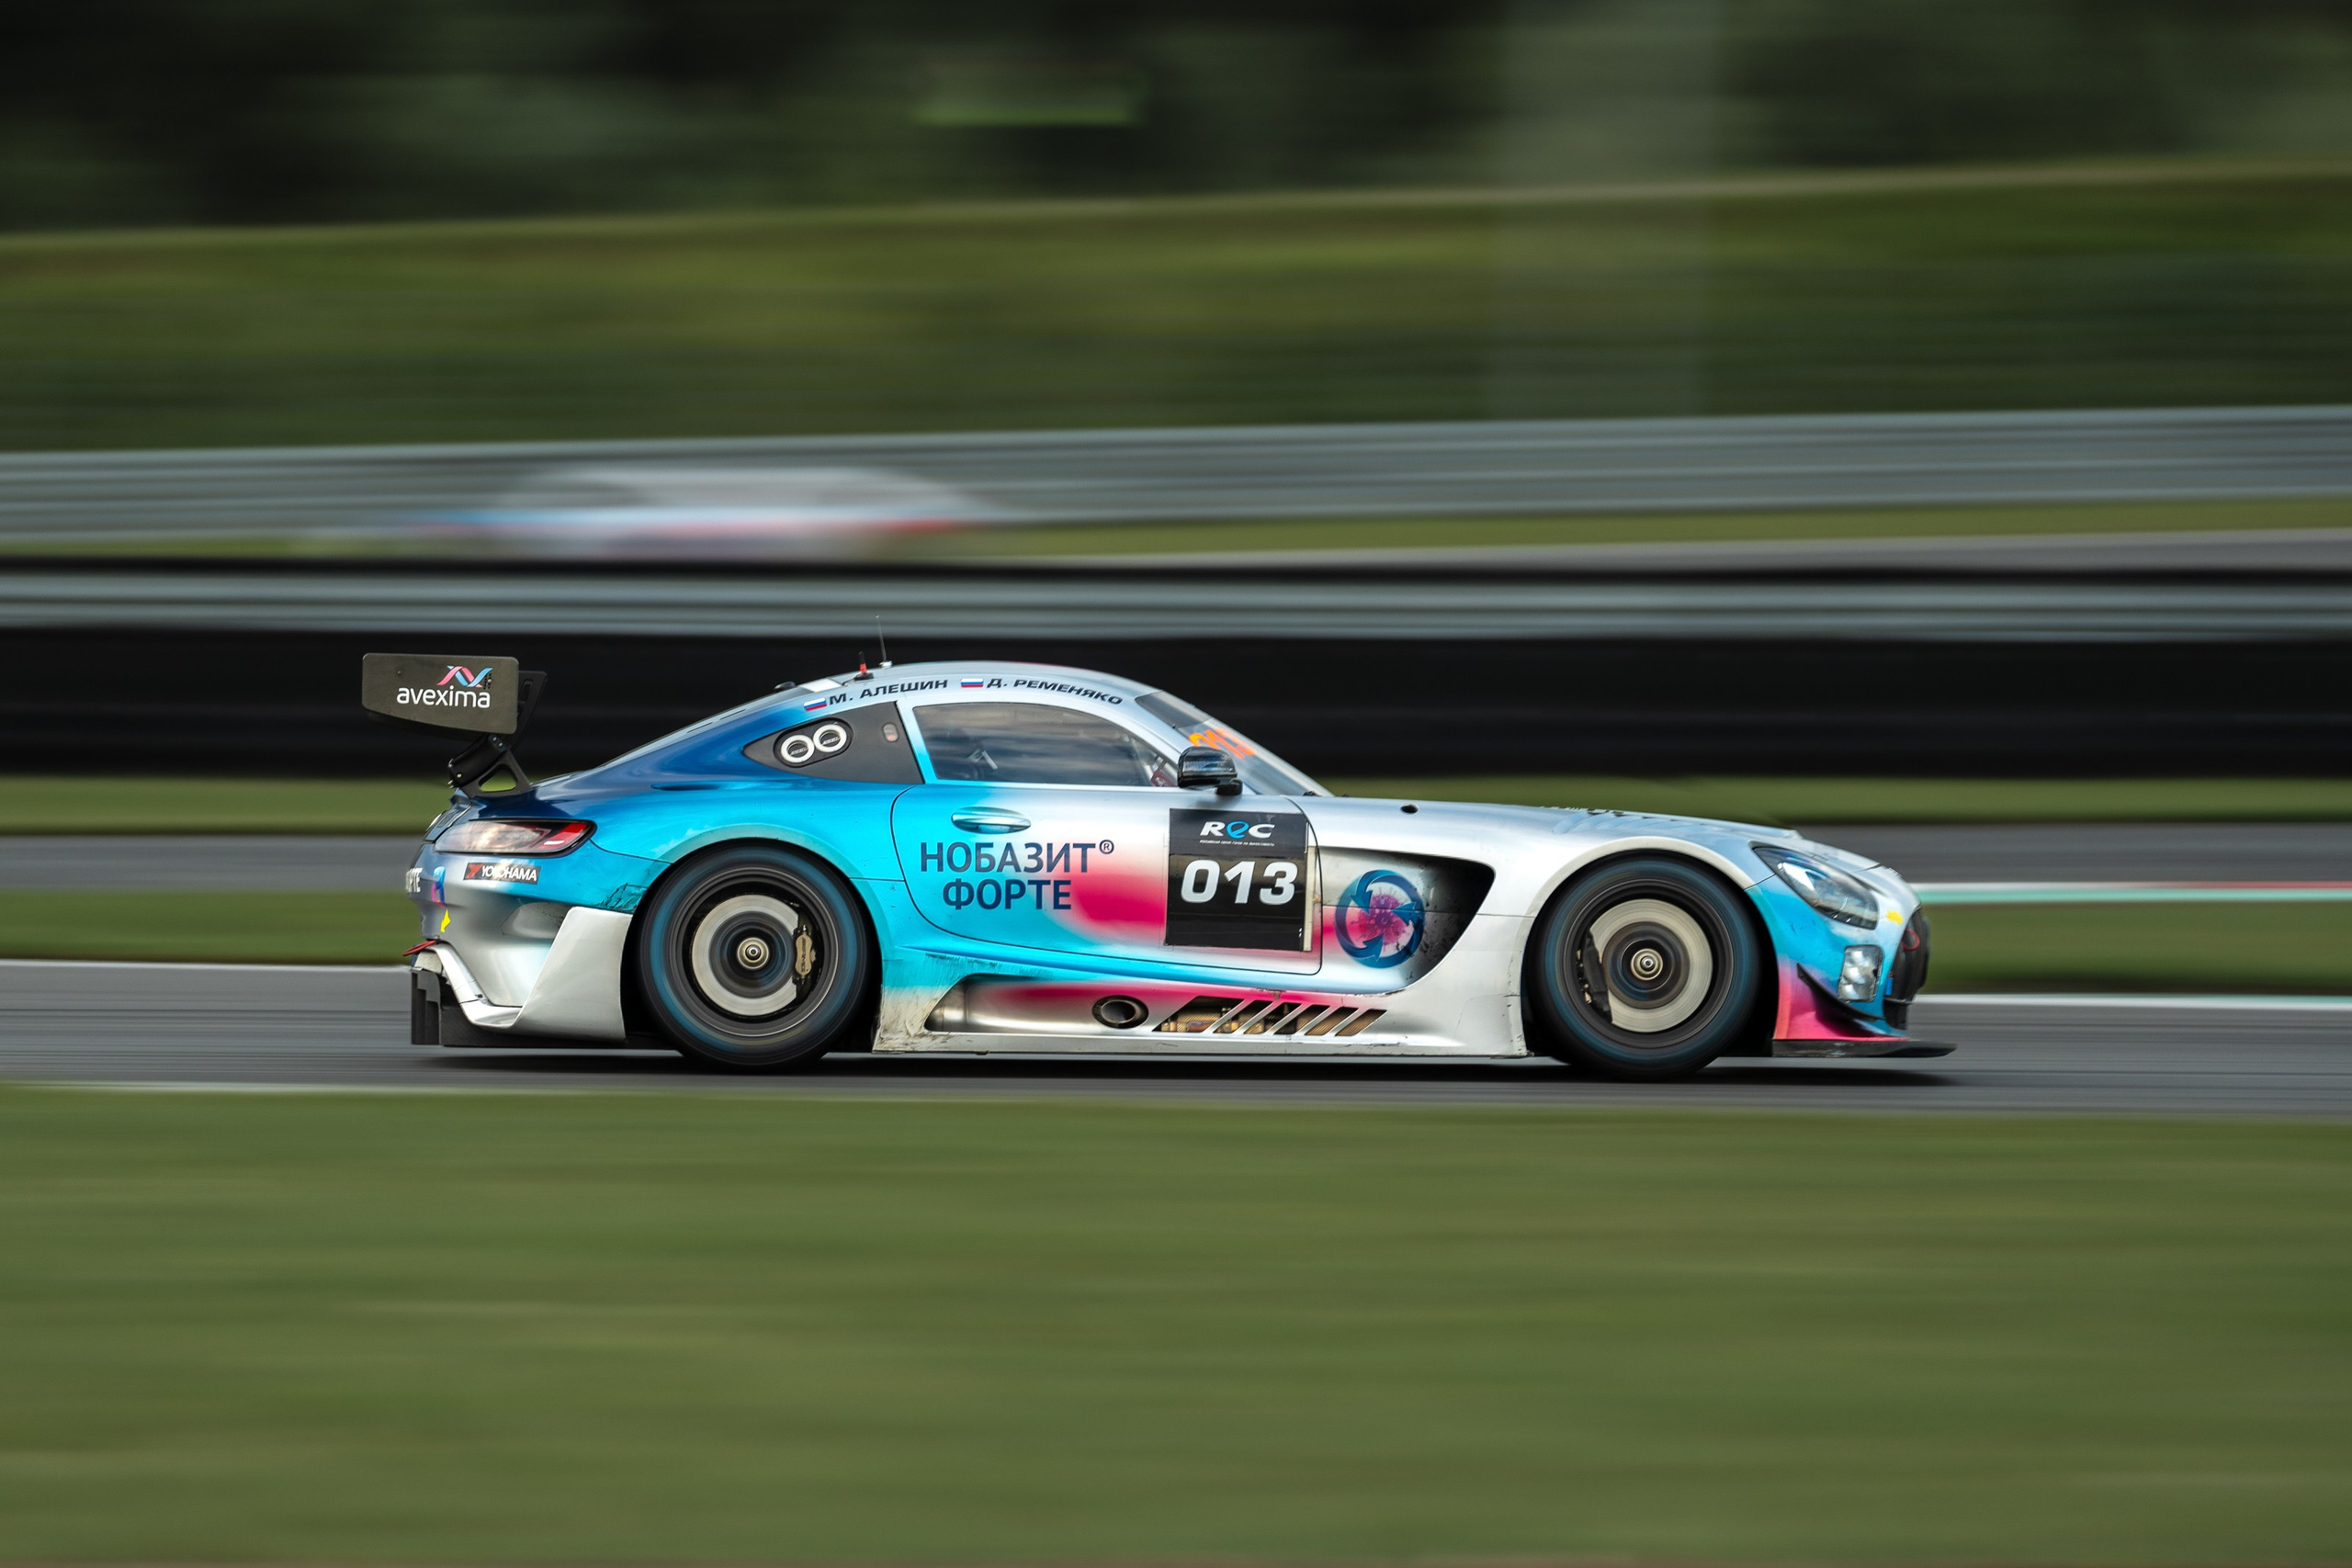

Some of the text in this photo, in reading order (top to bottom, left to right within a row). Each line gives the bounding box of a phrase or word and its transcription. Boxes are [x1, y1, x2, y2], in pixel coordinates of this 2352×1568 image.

[396, 684, 491, 708] avexima
[829, 680, 949, 705] М. АЛЕШИН
[986, 678, 1124, 705] Д. РЕМЕНЯКО
[481, 864, 537, 882] YOKOHAMA
[1180, 859, 1298, 906] 013
[943, 878, 1072, 910] ФОРТЕ
